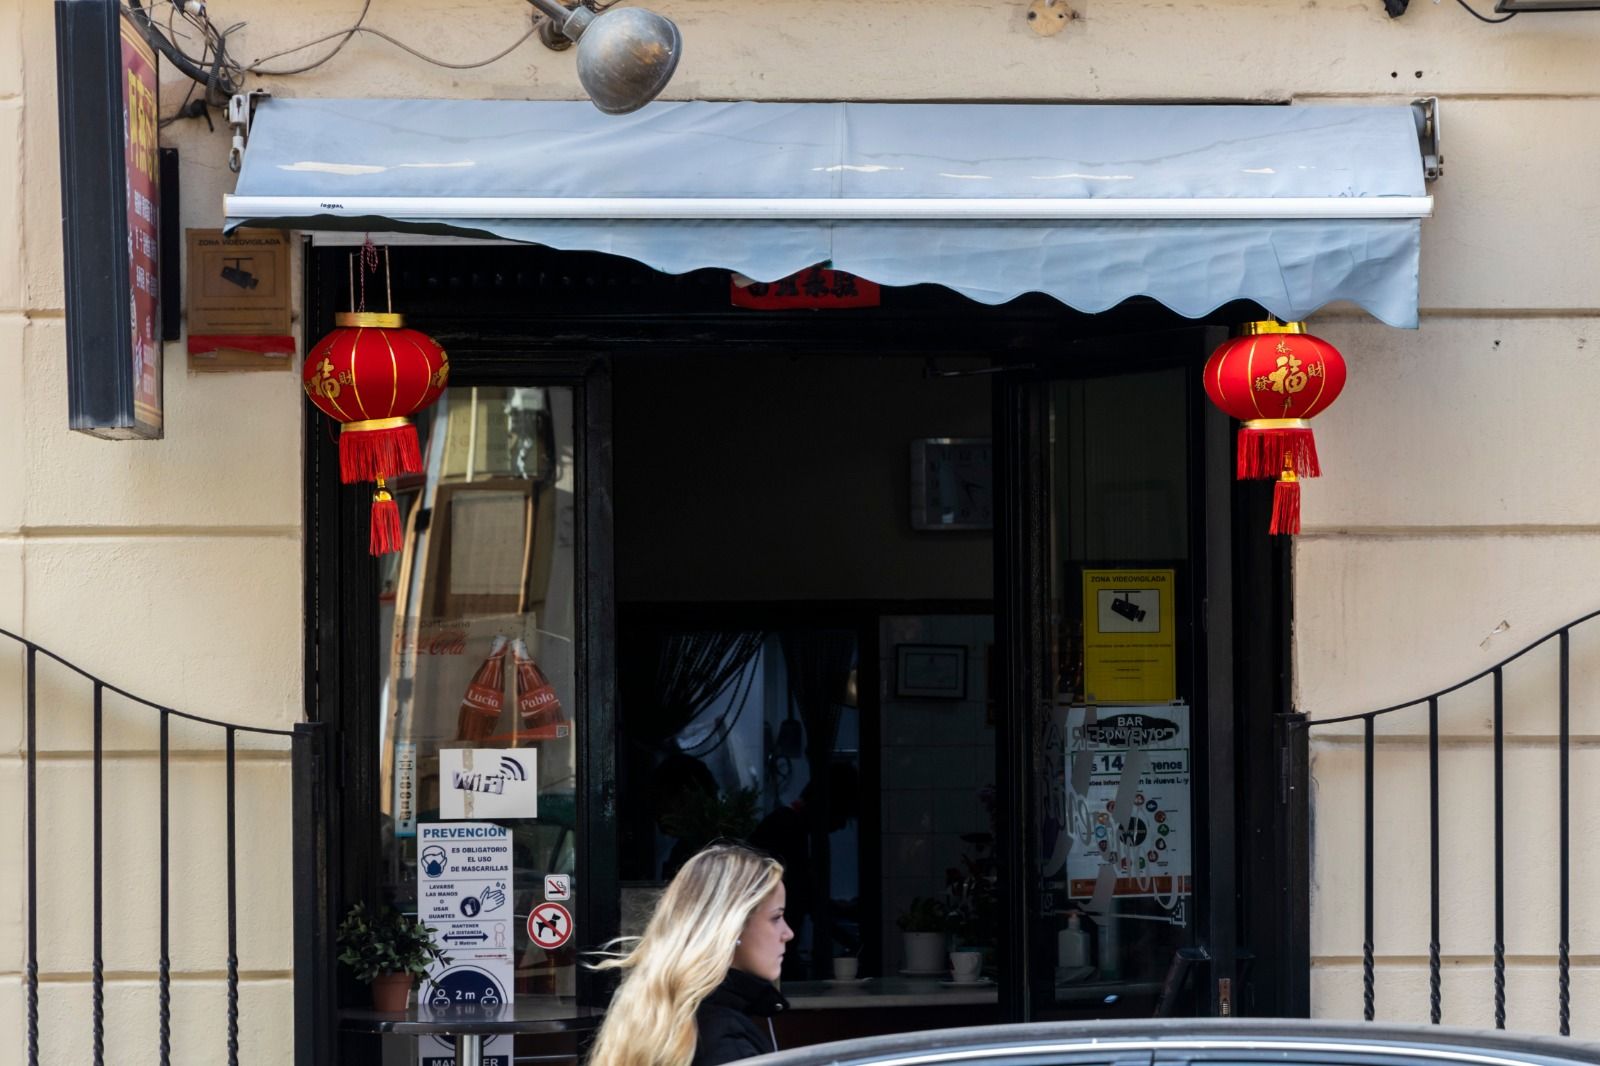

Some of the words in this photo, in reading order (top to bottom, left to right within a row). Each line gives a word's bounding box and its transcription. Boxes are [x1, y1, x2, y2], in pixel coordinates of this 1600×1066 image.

[311, 357, 341, 399] 福
[1268, 354, 1308, 394] 福
[521, 692, 554, 711] Pablo
[1117, 716, 1143, 727] BAR
[1101, 754, 1123, 771] 14
[455, 990, 462, 1000] 2
[465, 991, 475, 1000] m
